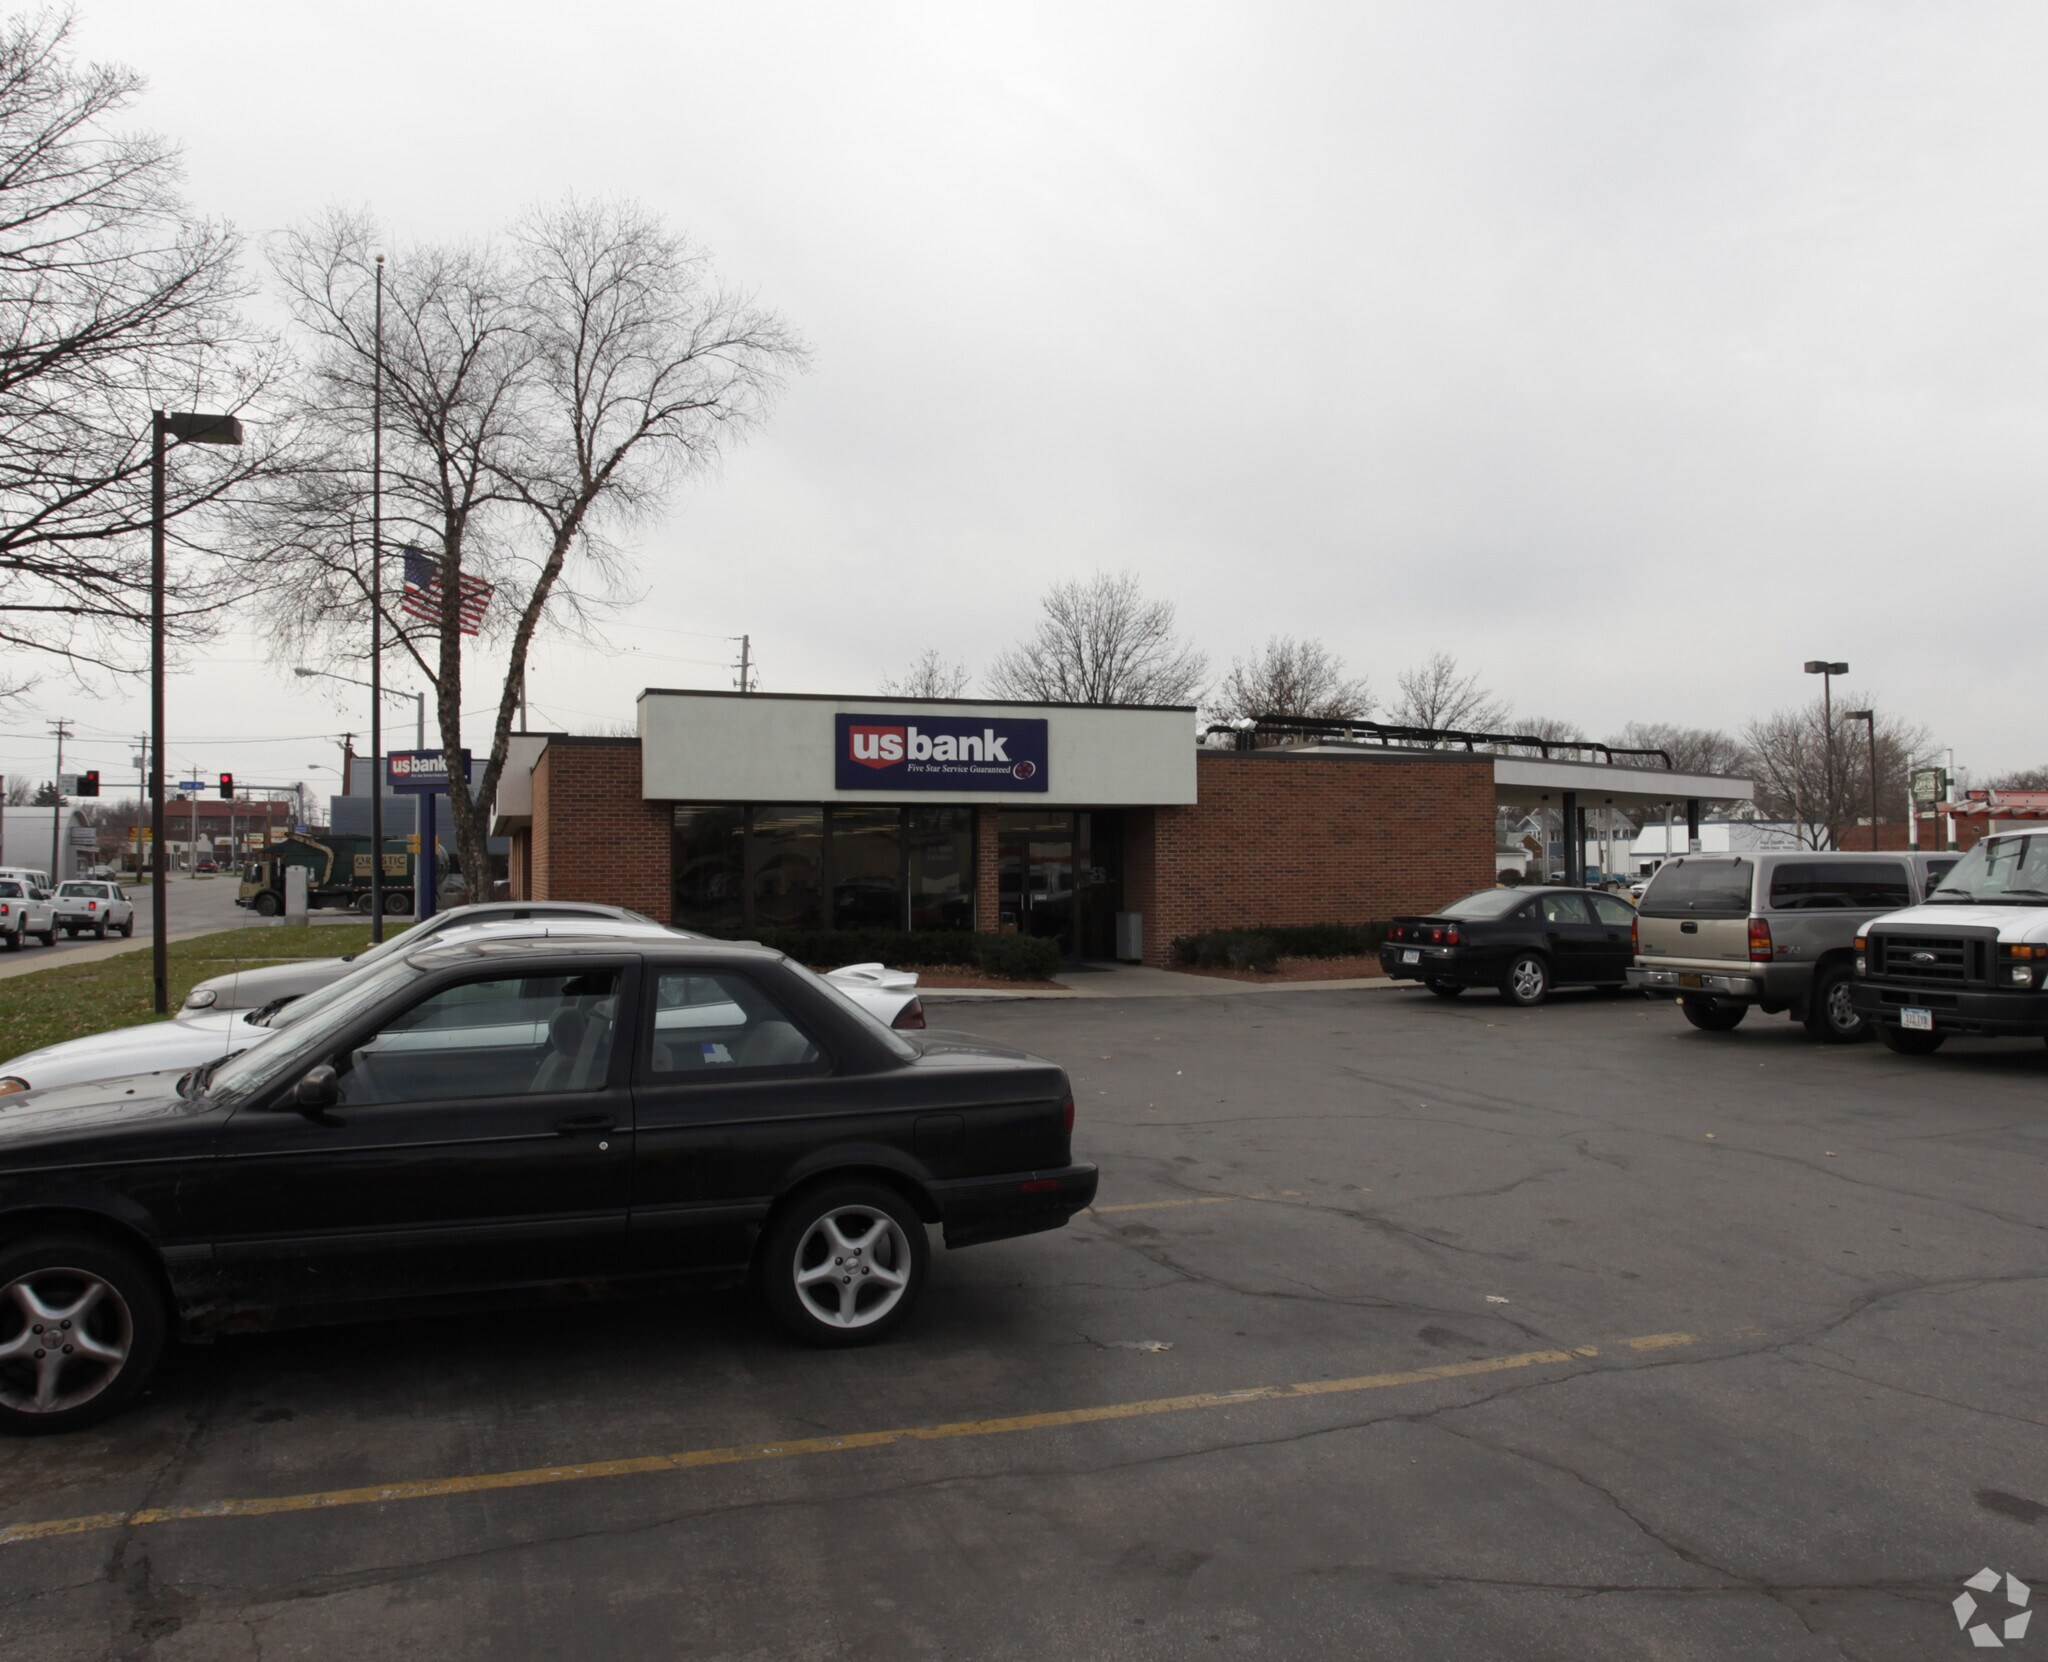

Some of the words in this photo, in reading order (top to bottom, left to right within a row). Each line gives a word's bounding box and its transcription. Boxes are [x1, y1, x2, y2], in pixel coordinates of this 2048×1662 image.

[907, 764, 924, 772] Five
[925, 764, 941, 773] Star
[942, 764, 968, 773] Service
[969, 765, 1011, 773] Guaranteed
[356, 856, 406, 864] ARSTIC
